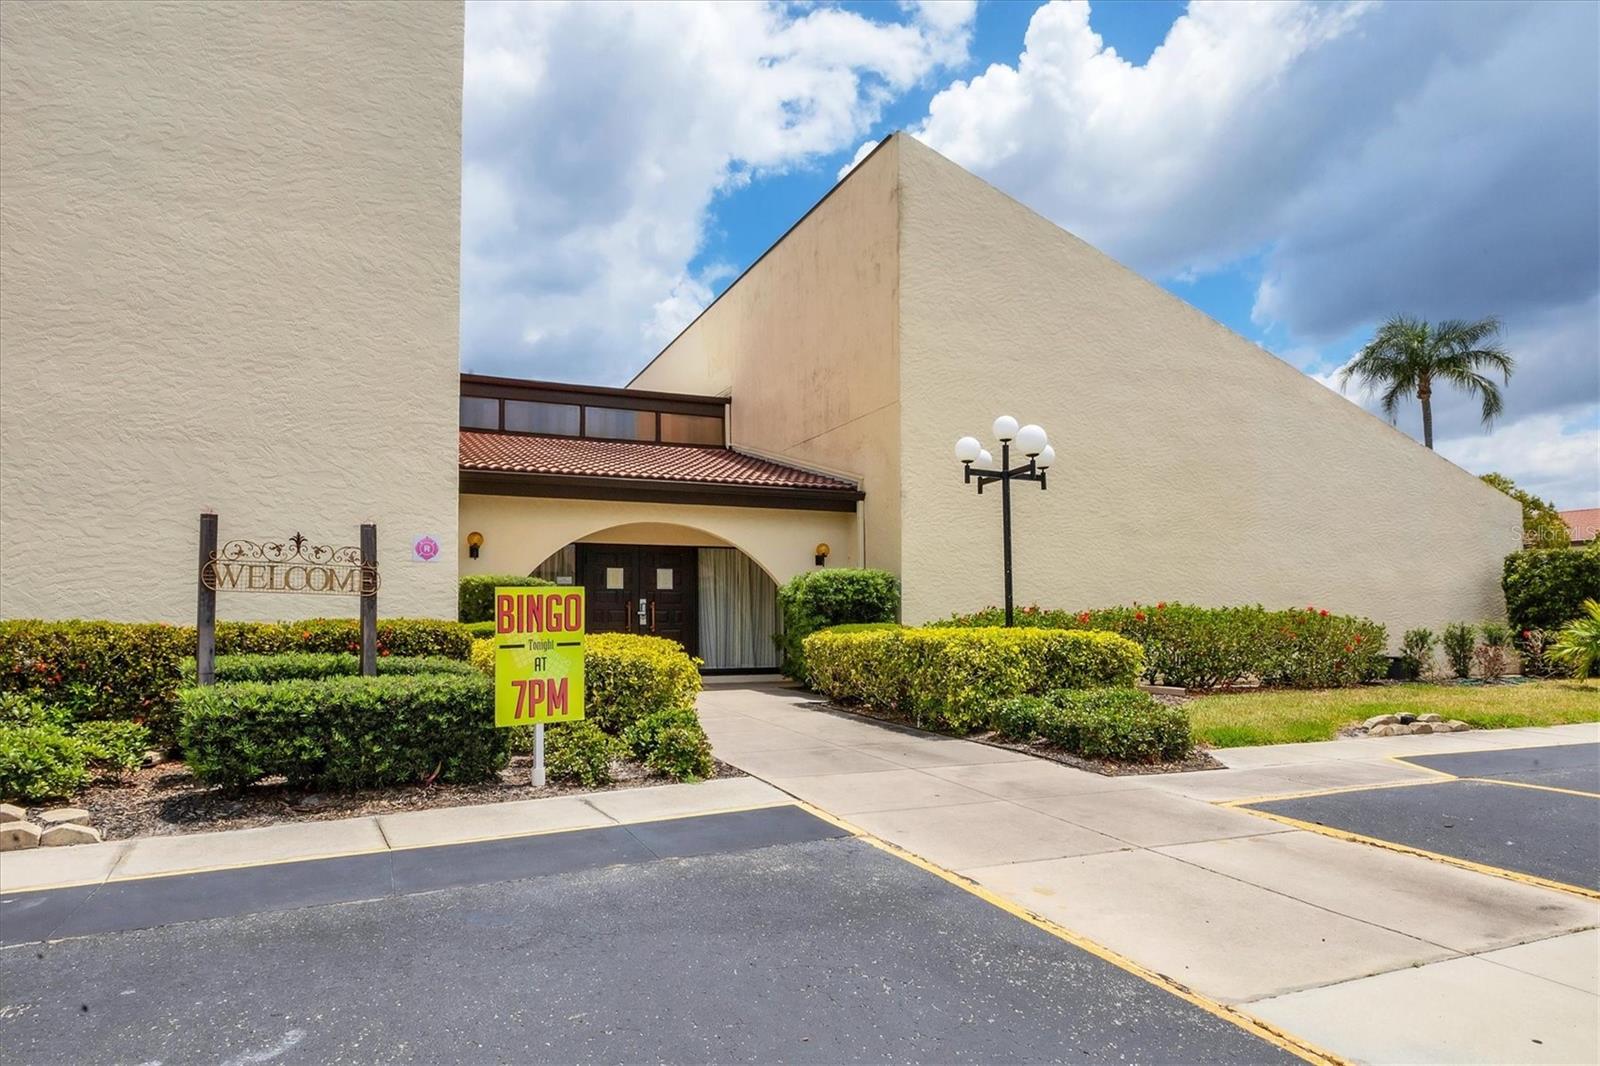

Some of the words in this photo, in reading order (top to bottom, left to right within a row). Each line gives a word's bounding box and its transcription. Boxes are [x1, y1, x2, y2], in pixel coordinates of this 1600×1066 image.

[209, 563, 376, 593] WELCOME
[497, 594, 582, 634] BINGO
[528, 638, 554, 652] Tonight
[534, 657, 547, 671] AT
[511, 677, 568, 720] 7PM
